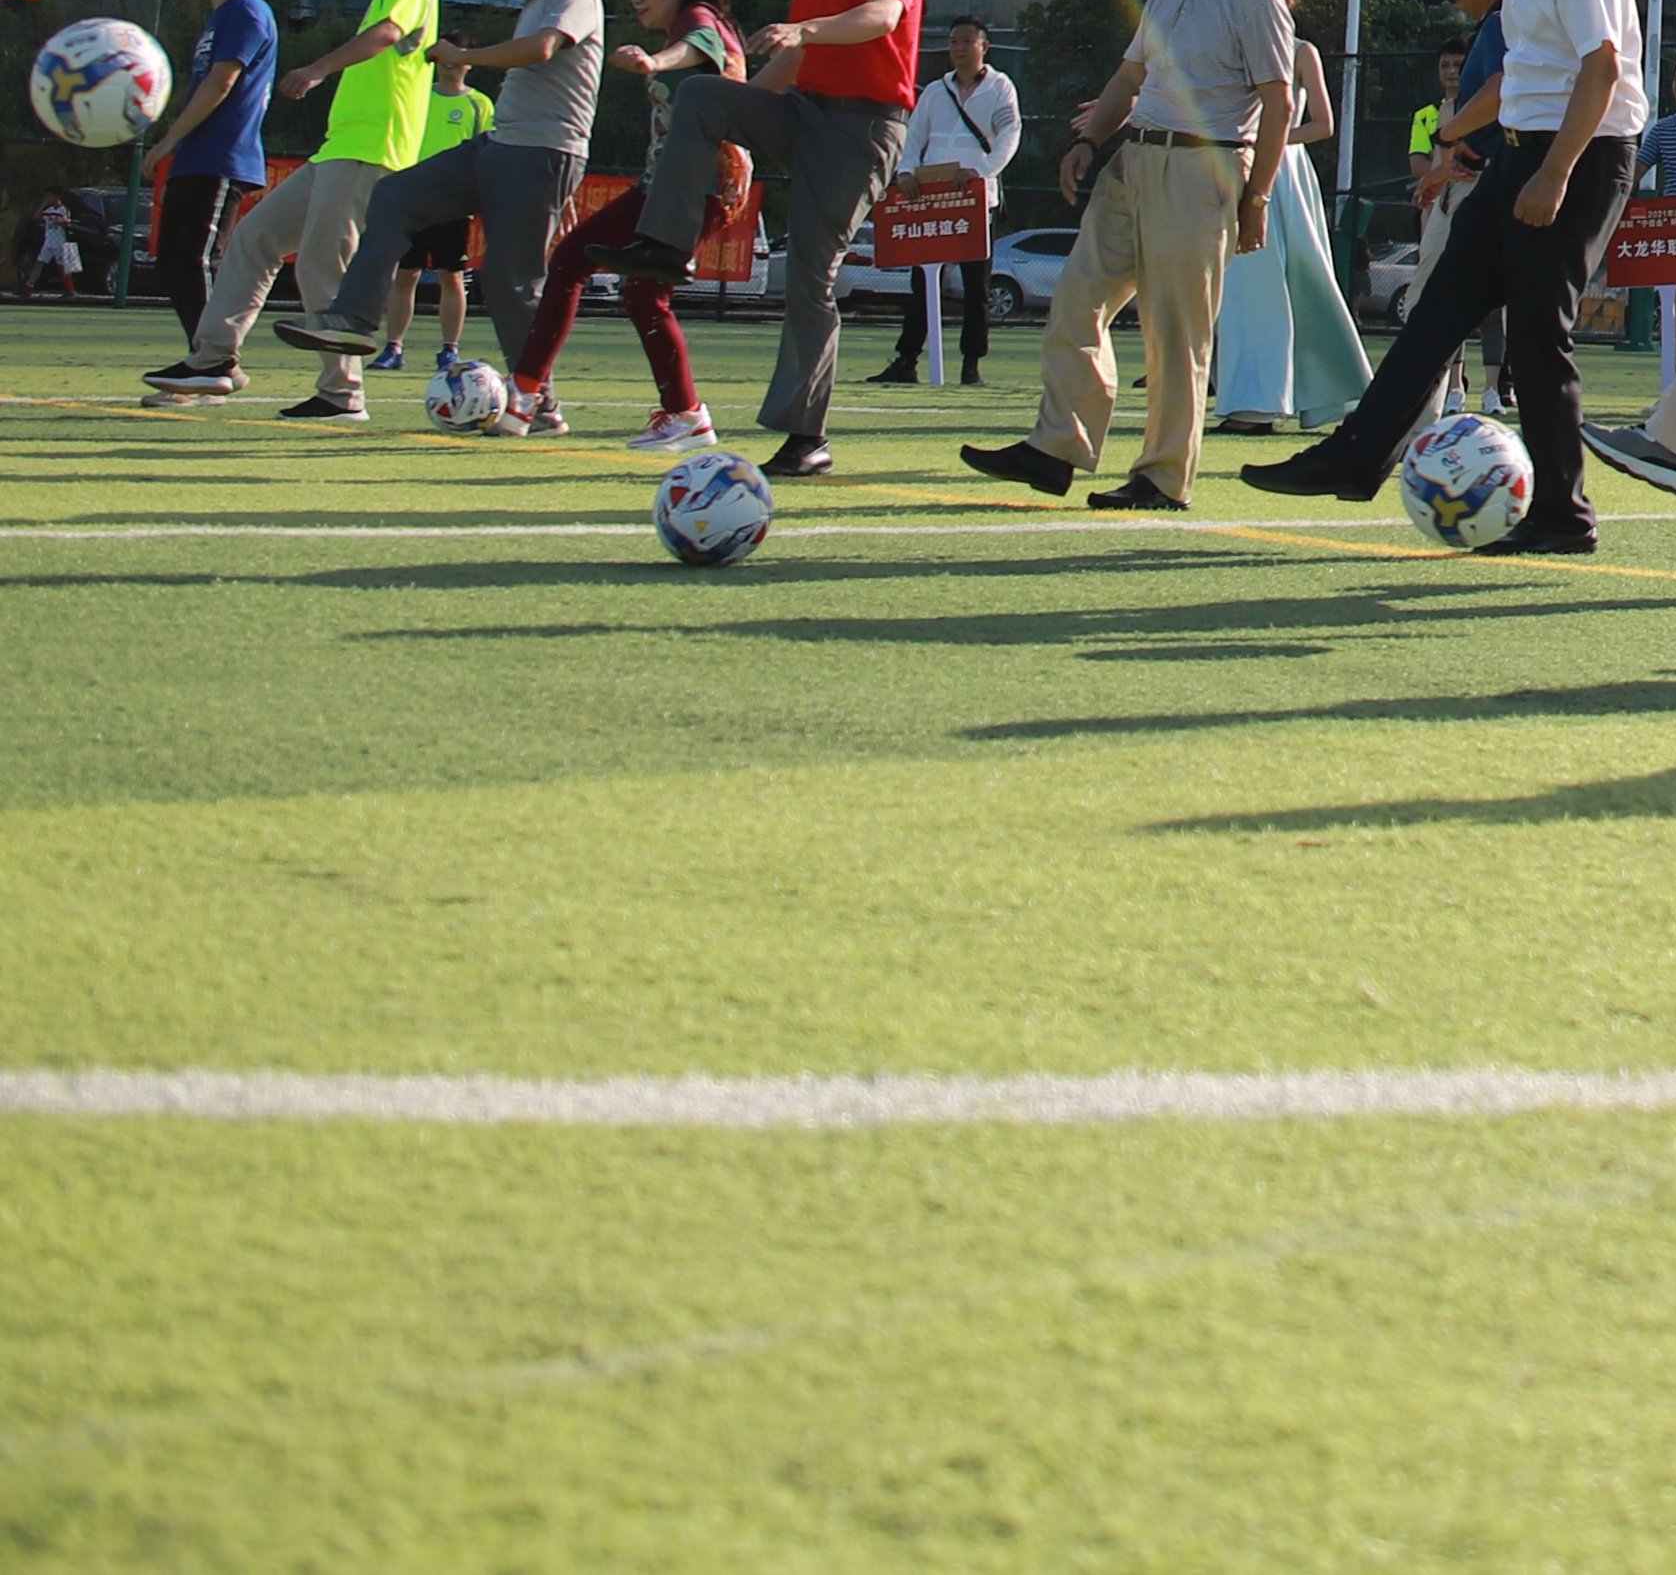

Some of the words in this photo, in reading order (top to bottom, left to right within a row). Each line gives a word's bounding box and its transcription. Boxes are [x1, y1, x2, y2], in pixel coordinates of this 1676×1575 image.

[891, 218, 970, 240] 坪山联谊会
